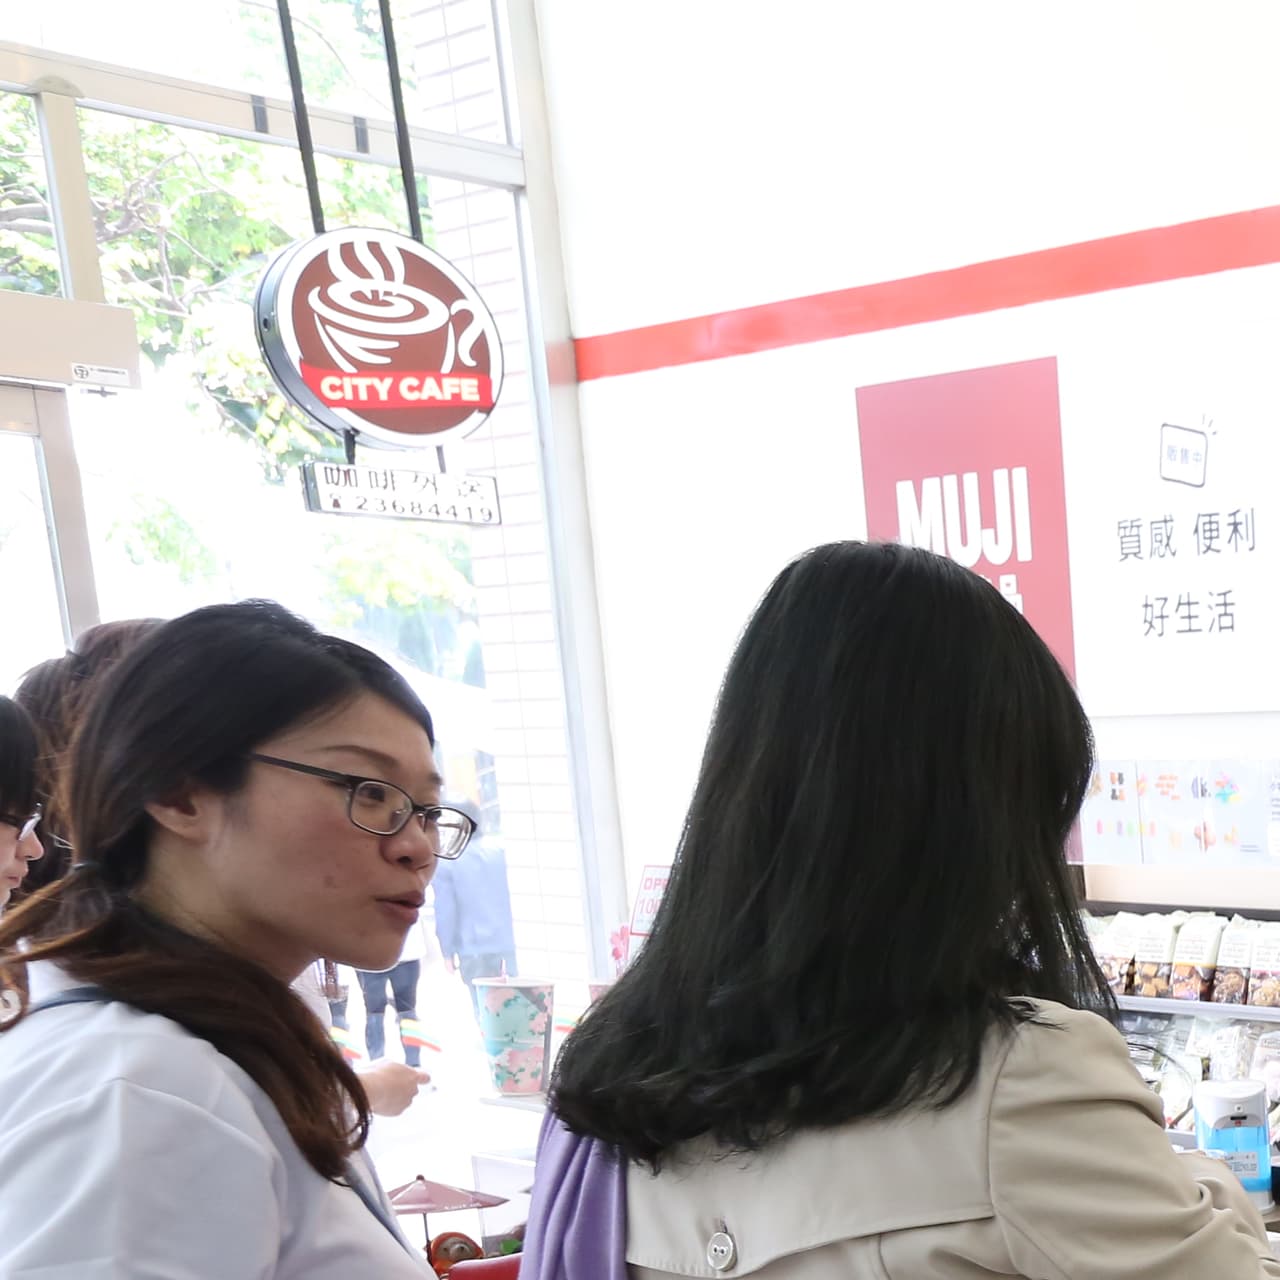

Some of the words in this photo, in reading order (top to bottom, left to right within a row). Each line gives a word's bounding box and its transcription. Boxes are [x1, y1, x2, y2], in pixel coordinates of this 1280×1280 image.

[320, 376, 393, 401] CITY
[399, 377, 481, 401] CAFE
[896, 467, 1032, 568] MUJI
[1117, 514, 1177, 561] 質感
[1192, 508, 1256, 556] 便利
[1142, 589, 1236, 637] 好生活
